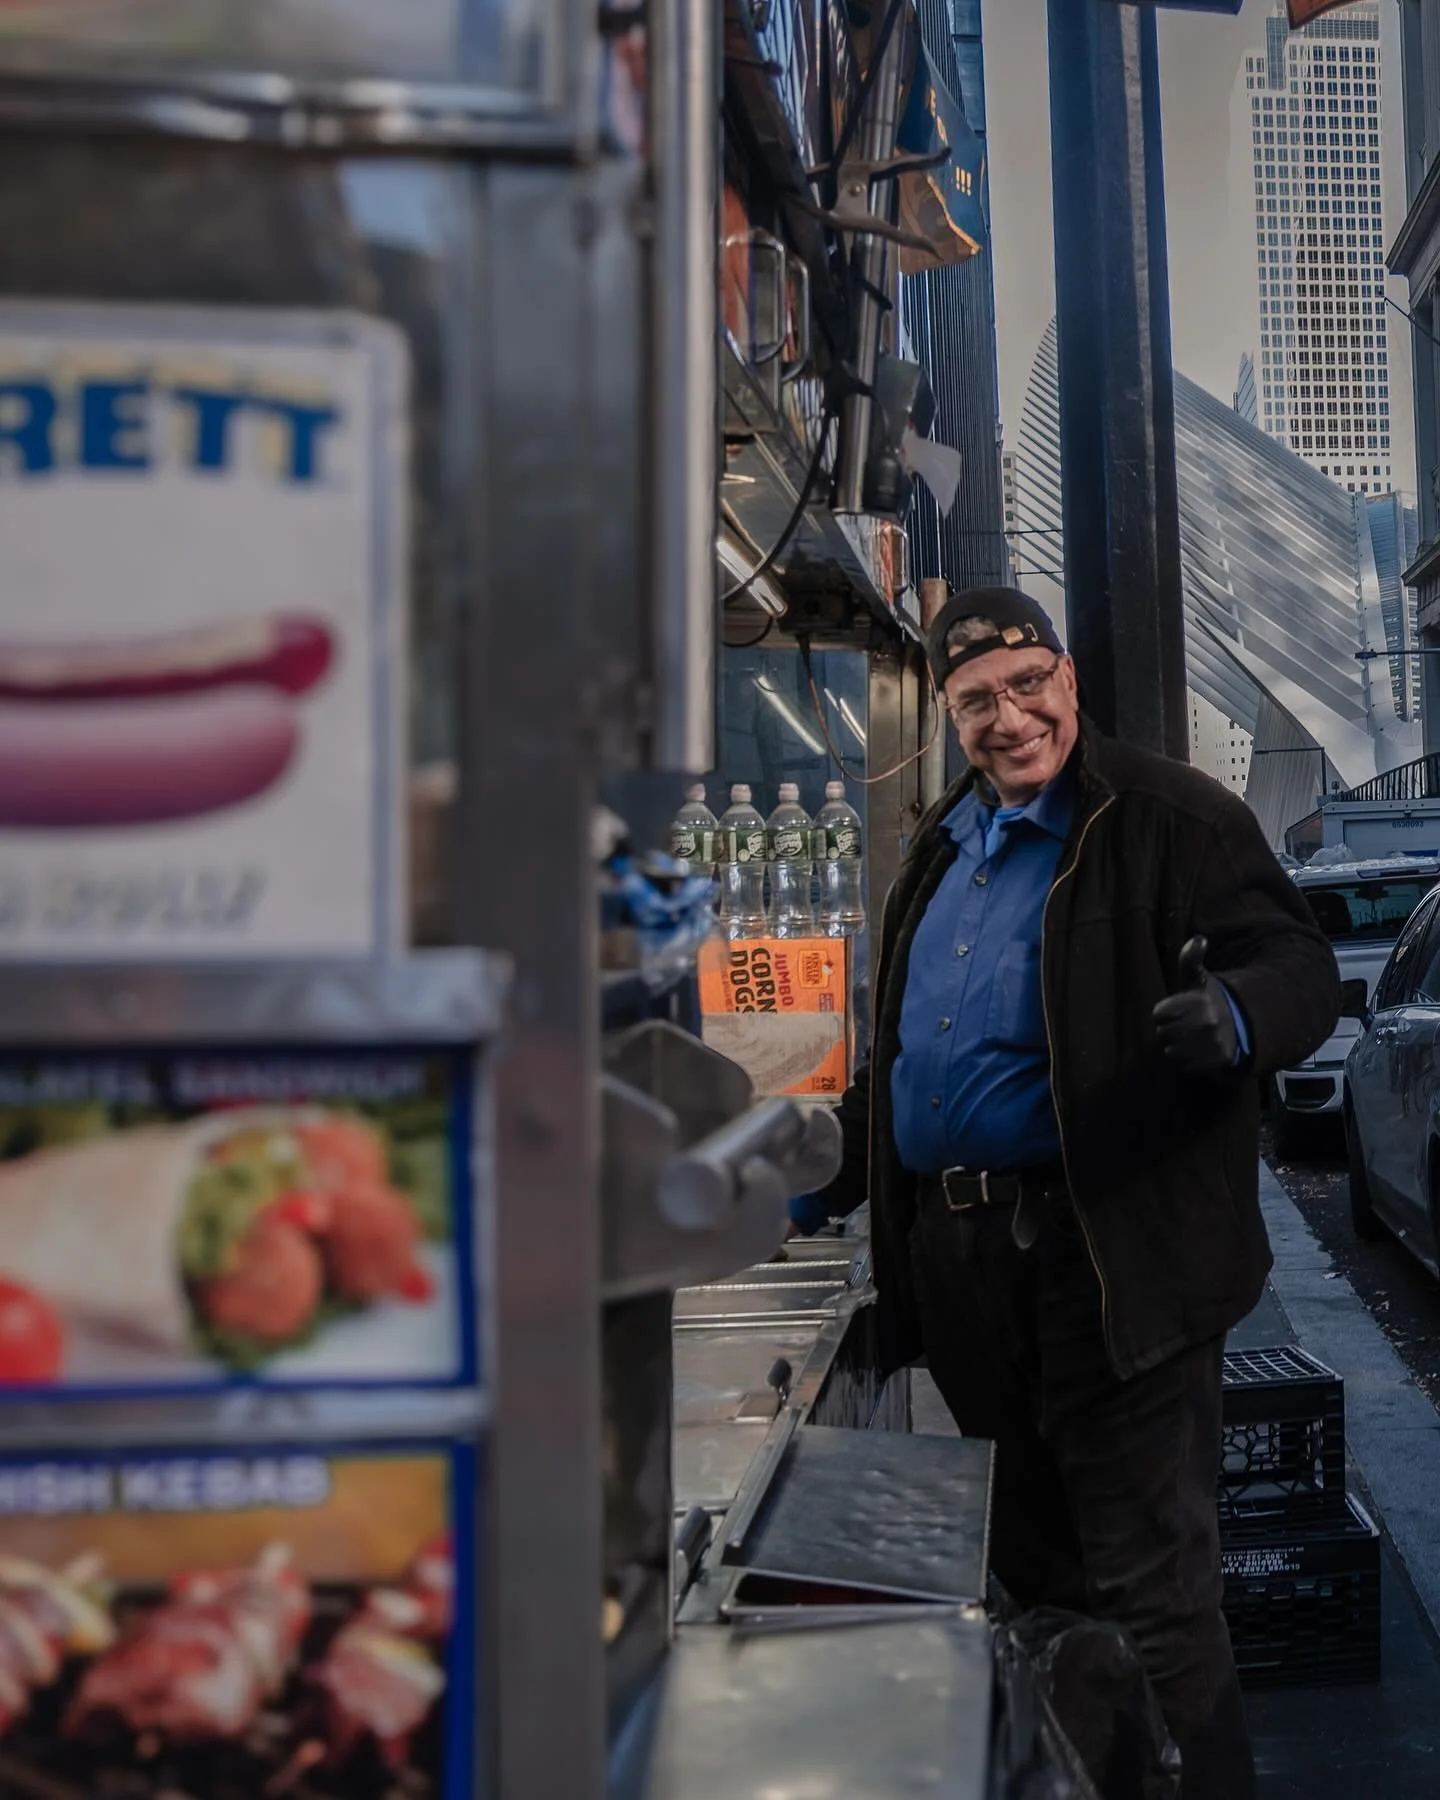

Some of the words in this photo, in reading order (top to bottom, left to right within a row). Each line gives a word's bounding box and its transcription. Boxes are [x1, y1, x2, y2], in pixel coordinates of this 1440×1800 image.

[751, 947, 777, 1014] CORN
[774, 952, 794, 1007] JUMBO
[123, 1456, 329, 1509] KEBAB
